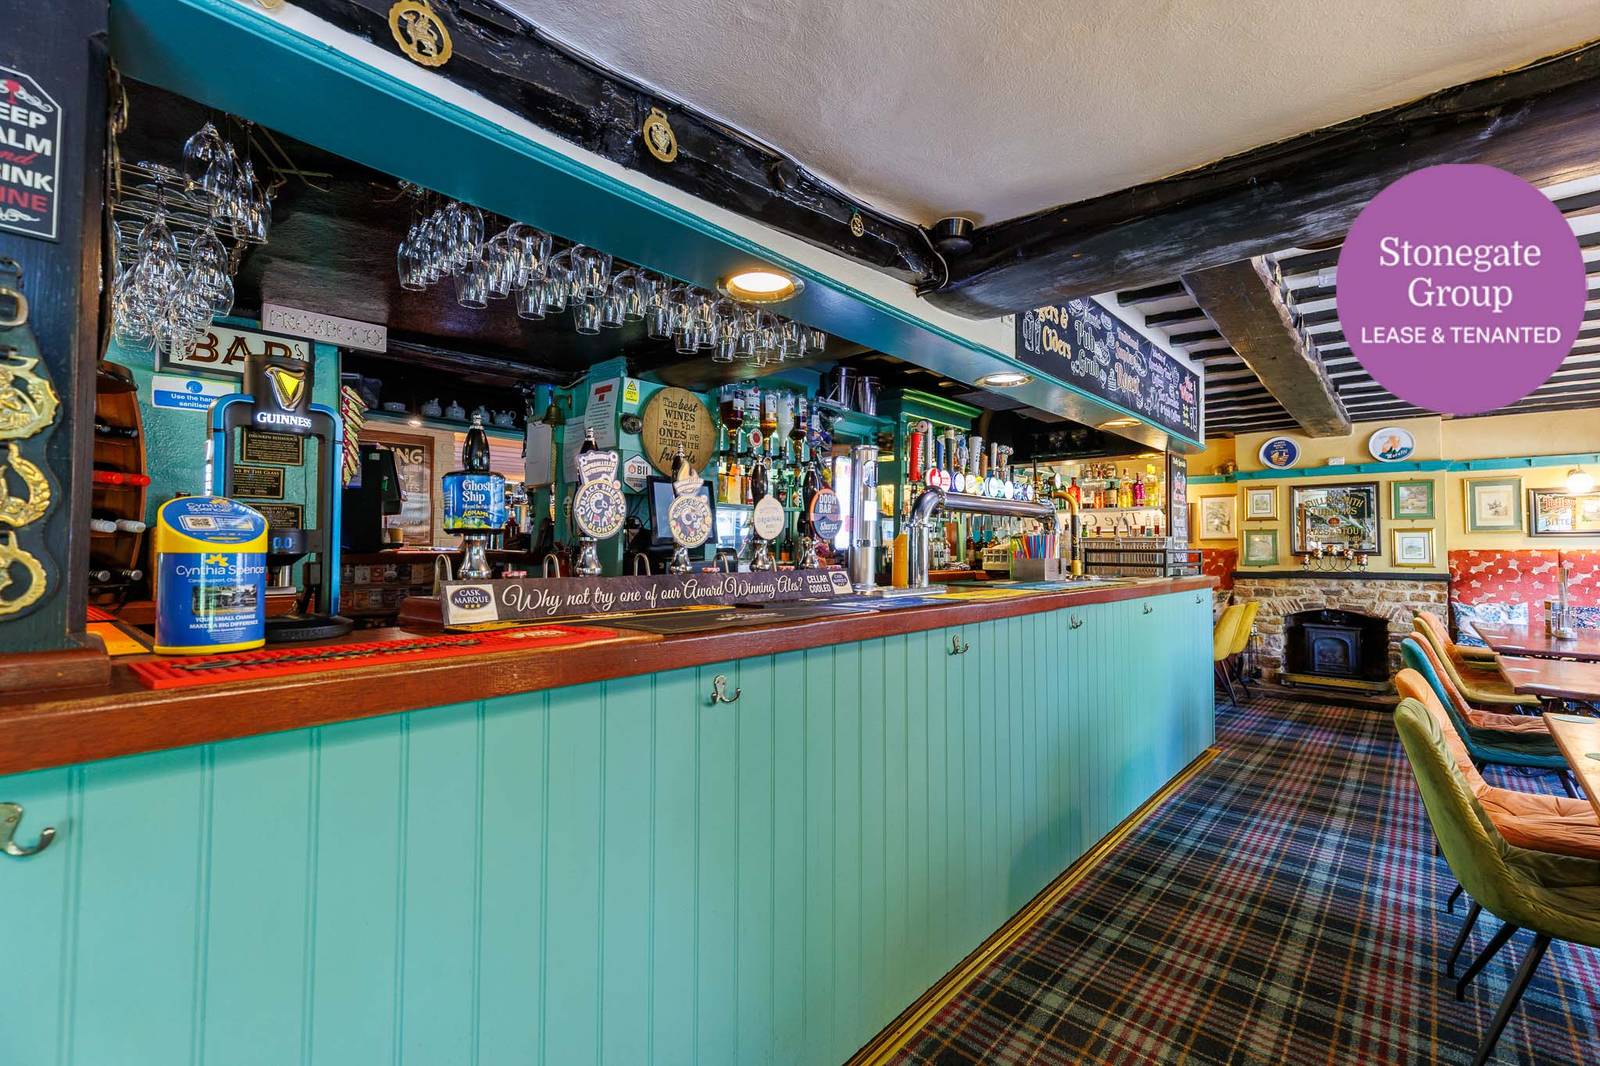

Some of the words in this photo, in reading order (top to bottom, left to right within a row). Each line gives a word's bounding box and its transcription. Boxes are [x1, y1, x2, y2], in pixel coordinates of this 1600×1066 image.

[170, 392, 183, 401] Use
[183, 393, 199, 402] the
[200, 395, 216, 404] han
[663, 396, 678, 408] The
[677, 395, 699, 412] best
[256, 411, 313, 429] GUINNESS
[664, 408, 696, 423] WINES
[662, 420, 679, 429] are
[681, 421, 696, 431] the
[659, 428, 687, 441] ONES
[659, 446, 697, 464] frids
[637, 465, 649, 476] BII
[462, 479, 493, 492] Ghost
[461, 491, 486, 504] Ship
[580, 485, 600, 507] BLACK
[601, 483, 622, 508] SHEEP
[819, 494, 837, 505] DOOM
[819, 503, 832, 514] BAR
[587, 520, 620, 533] BLONDE
[272, 536, 293, 550] 0.0
[176, 565, 226, 577] Cynthia
[806, 574, 828, 584] CELLAR
[459, 589, 480, 597] CASK
[502, 584, 562, 615] Why
[566, 588, 591, 606] not
[593, 588, 616, 611] try
[619, 590, 641, 602] one
[645, 583, 658, 609] of
[661, 588, 681, 600] our
[682, 578, 724, 599] Award
[724, 576, 776, 600] Winning
[775, 574, 803, 593] Ales?
[809, 584, 832, 594] COOLED
[454, 595, 489, 605] MARQUE
[230, 619, 258, 627] DIFFERENCE
[235, 613, 256, 621] CHANGE
